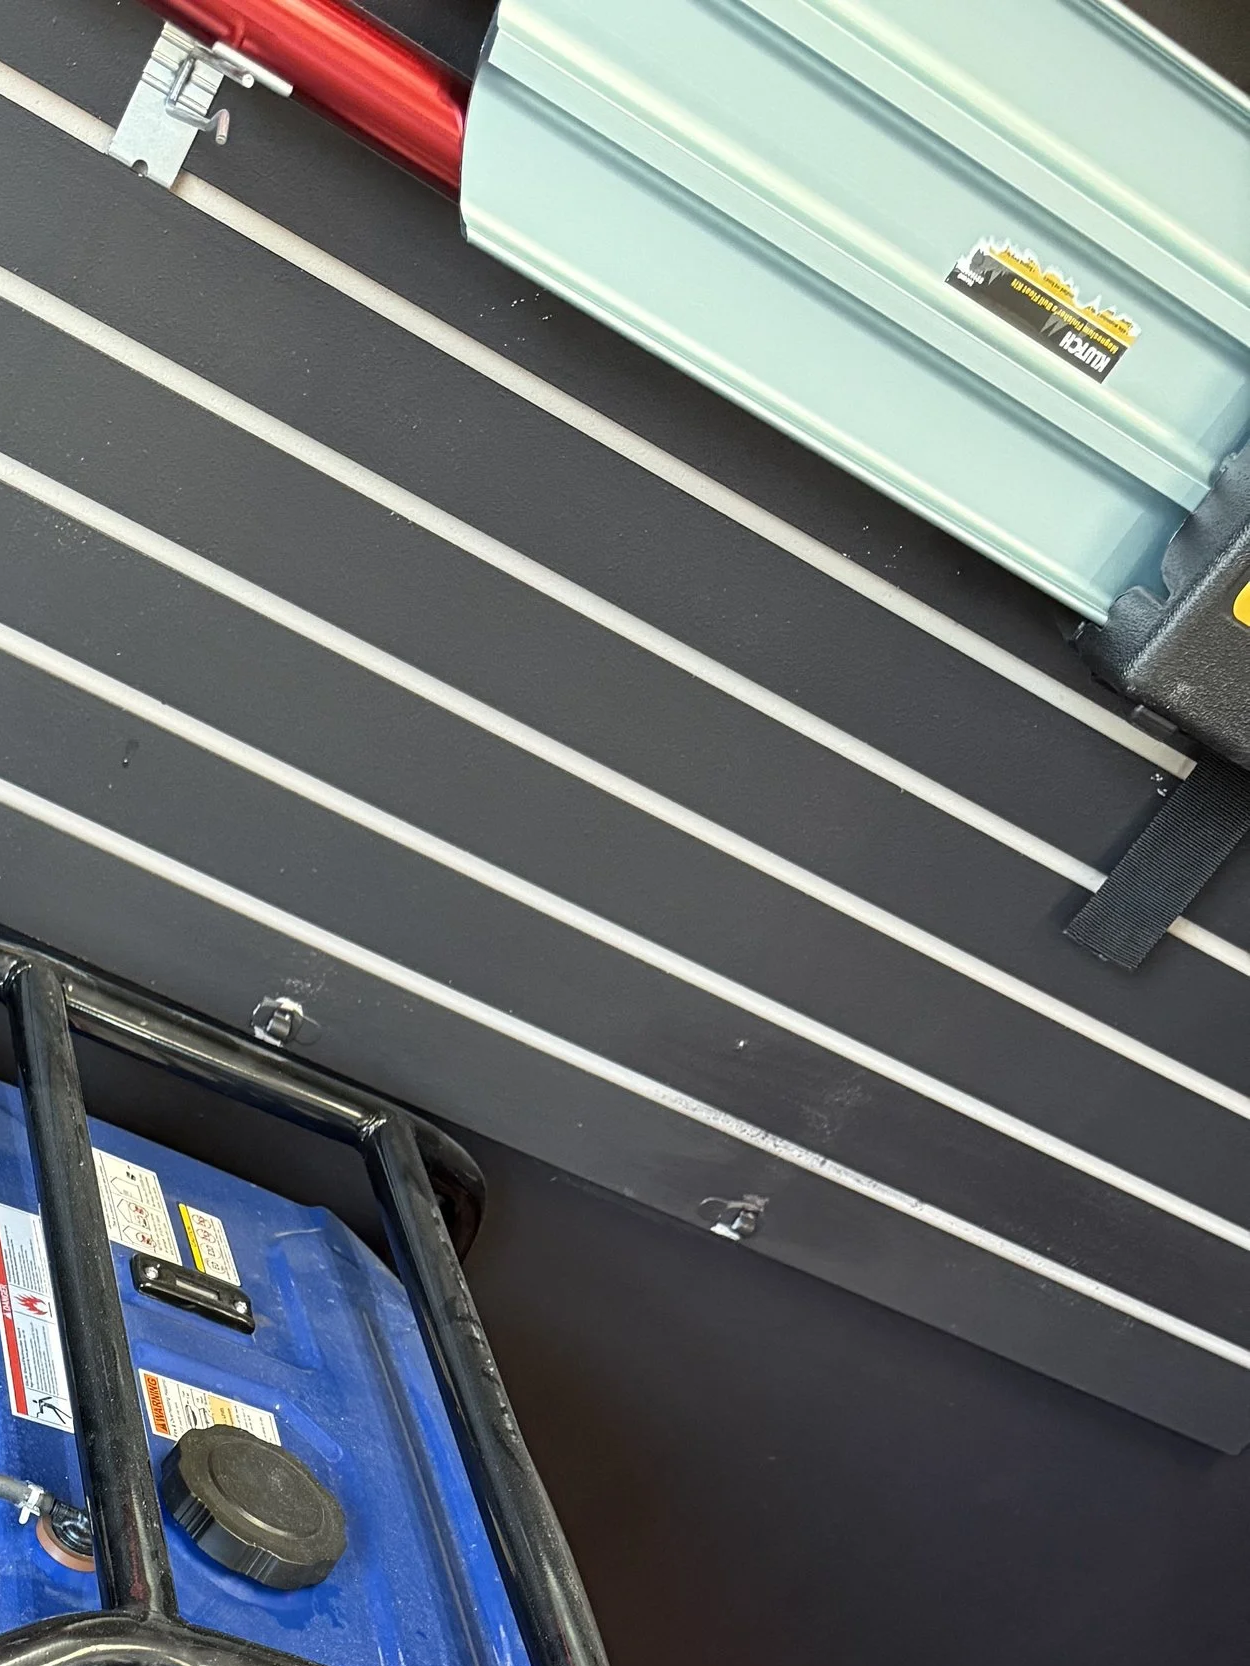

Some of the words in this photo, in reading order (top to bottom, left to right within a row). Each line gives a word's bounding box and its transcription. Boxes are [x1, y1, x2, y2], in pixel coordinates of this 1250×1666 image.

[1058, 330, 1111, 373] KLUTCH
[1081, 325, 1119, 354] Magnesium
[147, 1377, 165, 1423] WARNING
